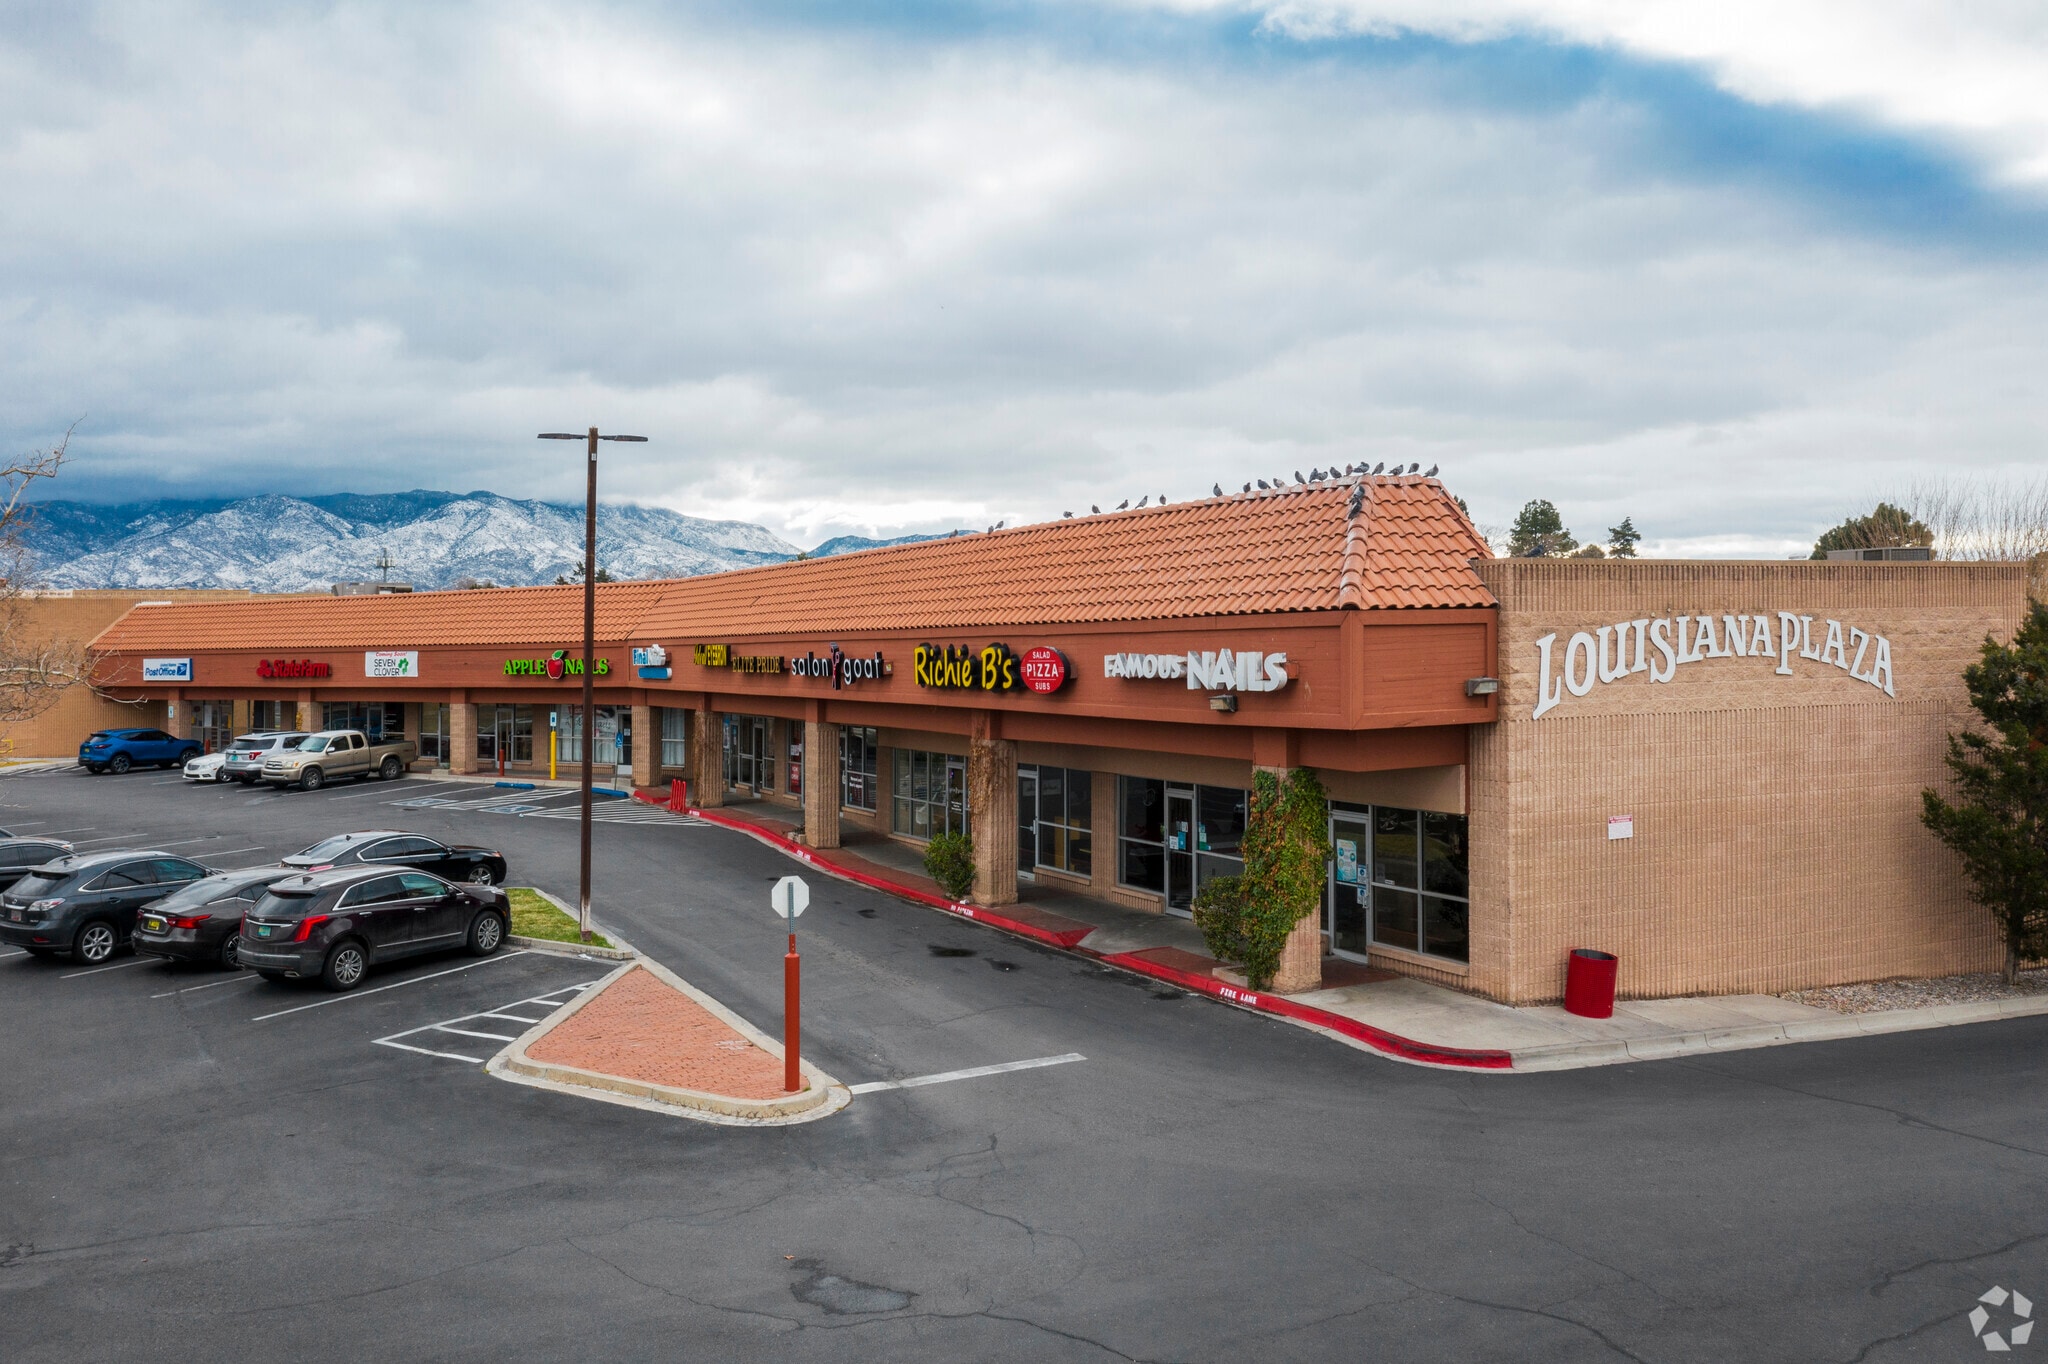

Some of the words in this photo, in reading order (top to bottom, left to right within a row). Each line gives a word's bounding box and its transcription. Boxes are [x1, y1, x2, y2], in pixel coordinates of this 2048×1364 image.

[374, 658, 396, 667] SEVEN
[1032, 651, 1051, 659] SALAD
[374, 667, 400, 677] CLOVER
[503, 659, 546, 675] APPLE
[564, 658, 609, 675] NALS
[732, 656, 754, 673] ELITE
[756, 656, 780, 673] PRIDE
[791, 651, 829, 677] salon
[843, 651, 879, 685] goat
[914, 646, 973, 687] Richie
[980, 646, 1013, 690] B's
[1026, 663, 1059, 678] PIZZA
[1104, 652, 1186, 679] FAMOUS
[1187, 648, 1288, 692] NAILS
[1532, 614, 1776, 720] LOUISIANA
[1775, 611, 1895, 699] PLAZA
[1035, 682, 1051, 690] SUBS
[1219, 987, 1237, 999] FIRE
[1240, 993, 1257, 1005] LANE
